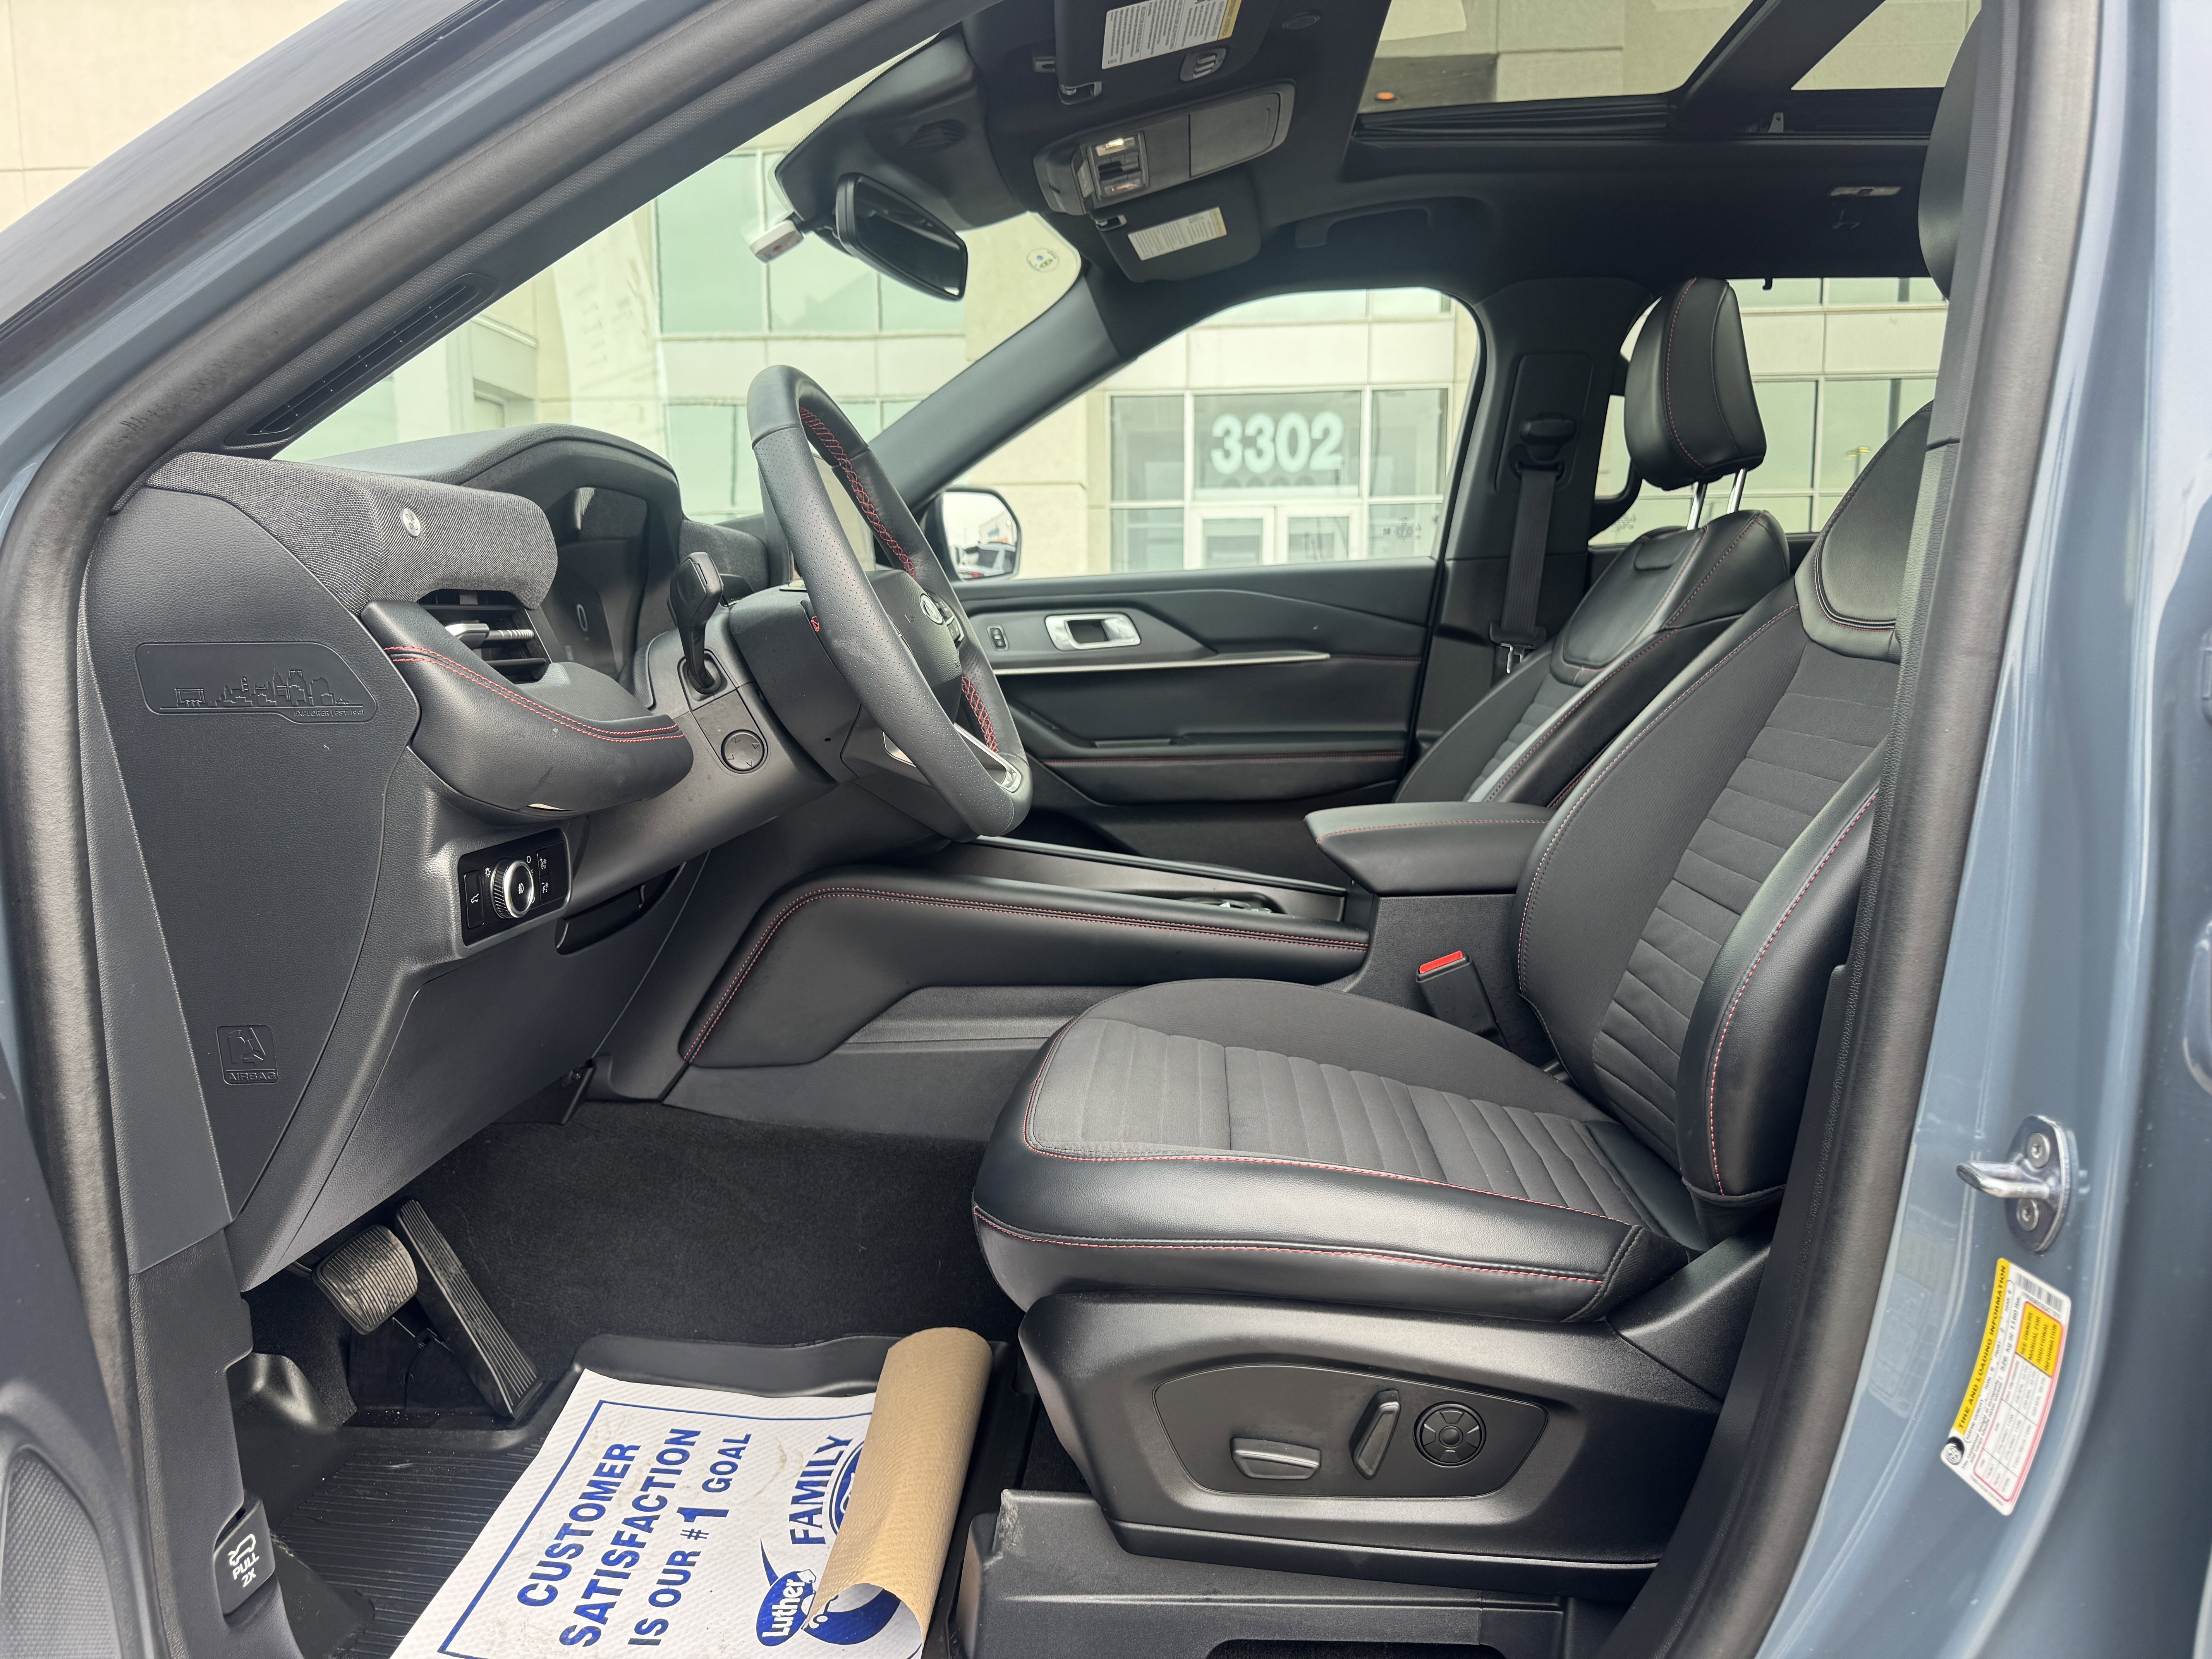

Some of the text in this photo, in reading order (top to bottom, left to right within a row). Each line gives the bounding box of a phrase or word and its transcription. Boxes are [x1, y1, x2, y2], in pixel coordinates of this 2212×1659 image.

[1211, 410, 1345, 474] 3302
[229, 1072, 276, 1081] AIRBAG
[1957, 1264, 2006, 1428] TIRE AND LOADING INFORMATION
[2004, 1341, 2012, 1353] kg
[2022, 1311, 2033, 1341] OWNERS
[2027, 1331, 2038, 1361] MANUAL
[2035, 1323, 2048, 1364] ADDITIONAL
[2042, 1322, 2058, 1372] INFORMATION
[1966, 1431, 1980, 1459] combined
[788, 1434, 854, 1545] FAMILY
[518, 1444, 640, 1606] CUSTOMER
[560, 1429, 701, 1647] SATISFACTION
[628, 1620, 668, 1647] IS
[649, 1551, 701, 1607] OUR
[701, 1433, 752, 1493] GOAL
[232, 1552, 260, 1580] PULL
[241, 1568, 256, 1587] 2X
[761, 1578, 805, 1638] Luther
